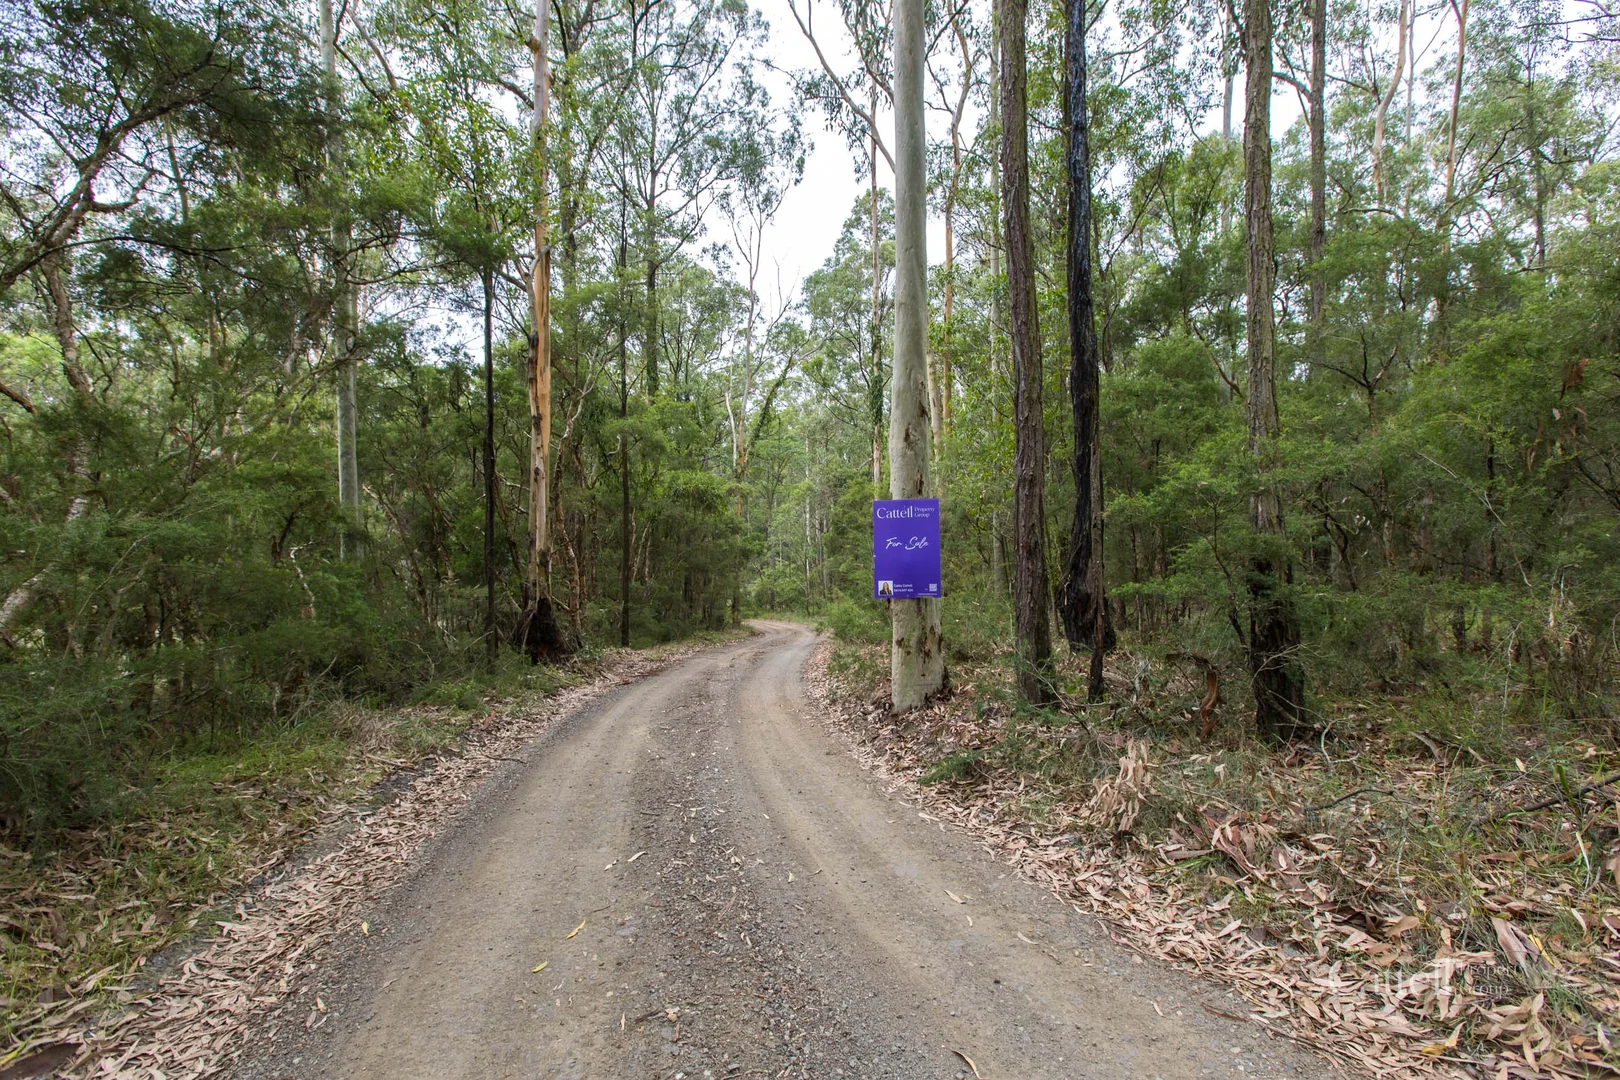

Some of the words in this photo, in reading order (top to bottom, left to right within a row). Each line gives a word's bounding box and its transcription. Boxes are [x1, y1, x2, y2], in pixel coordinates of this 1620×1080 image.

[876, 505, 913, 519] Cattell
[885, 536, 902, 550] For
[905, 536, 929, 550] Sale
